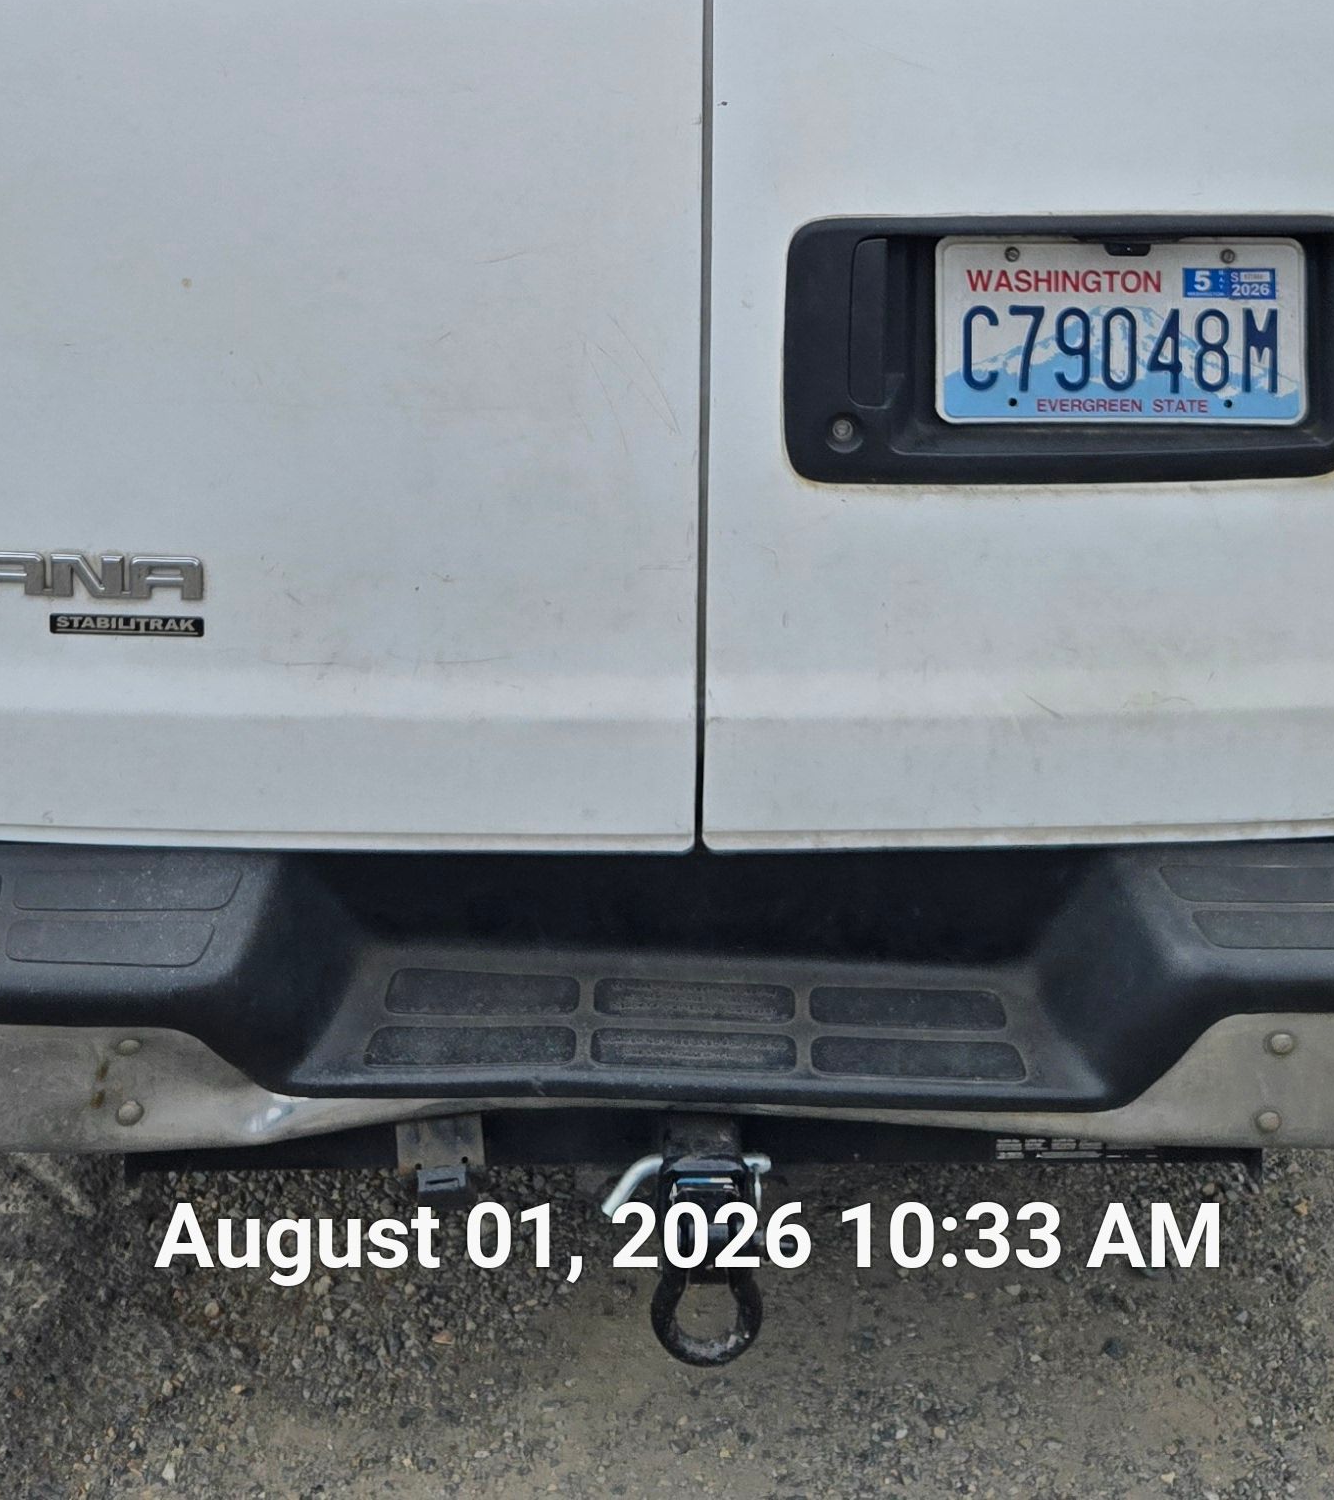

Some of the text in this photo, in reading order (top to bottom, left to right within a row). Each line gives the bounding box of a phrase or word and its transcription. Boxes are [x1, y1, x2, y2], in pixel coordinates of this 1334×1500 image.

[966, 269, 1162, 293] WASHINGTON
[1193, 270, 1211, 291] 5
[1231, 284, 1270, 296] 2026
[962, 304, 1279, 395] C79048M
[1036, 398, 1208, 414] EVERGREEN STATE
[56, 615, 198, 634] STABILITRAK
